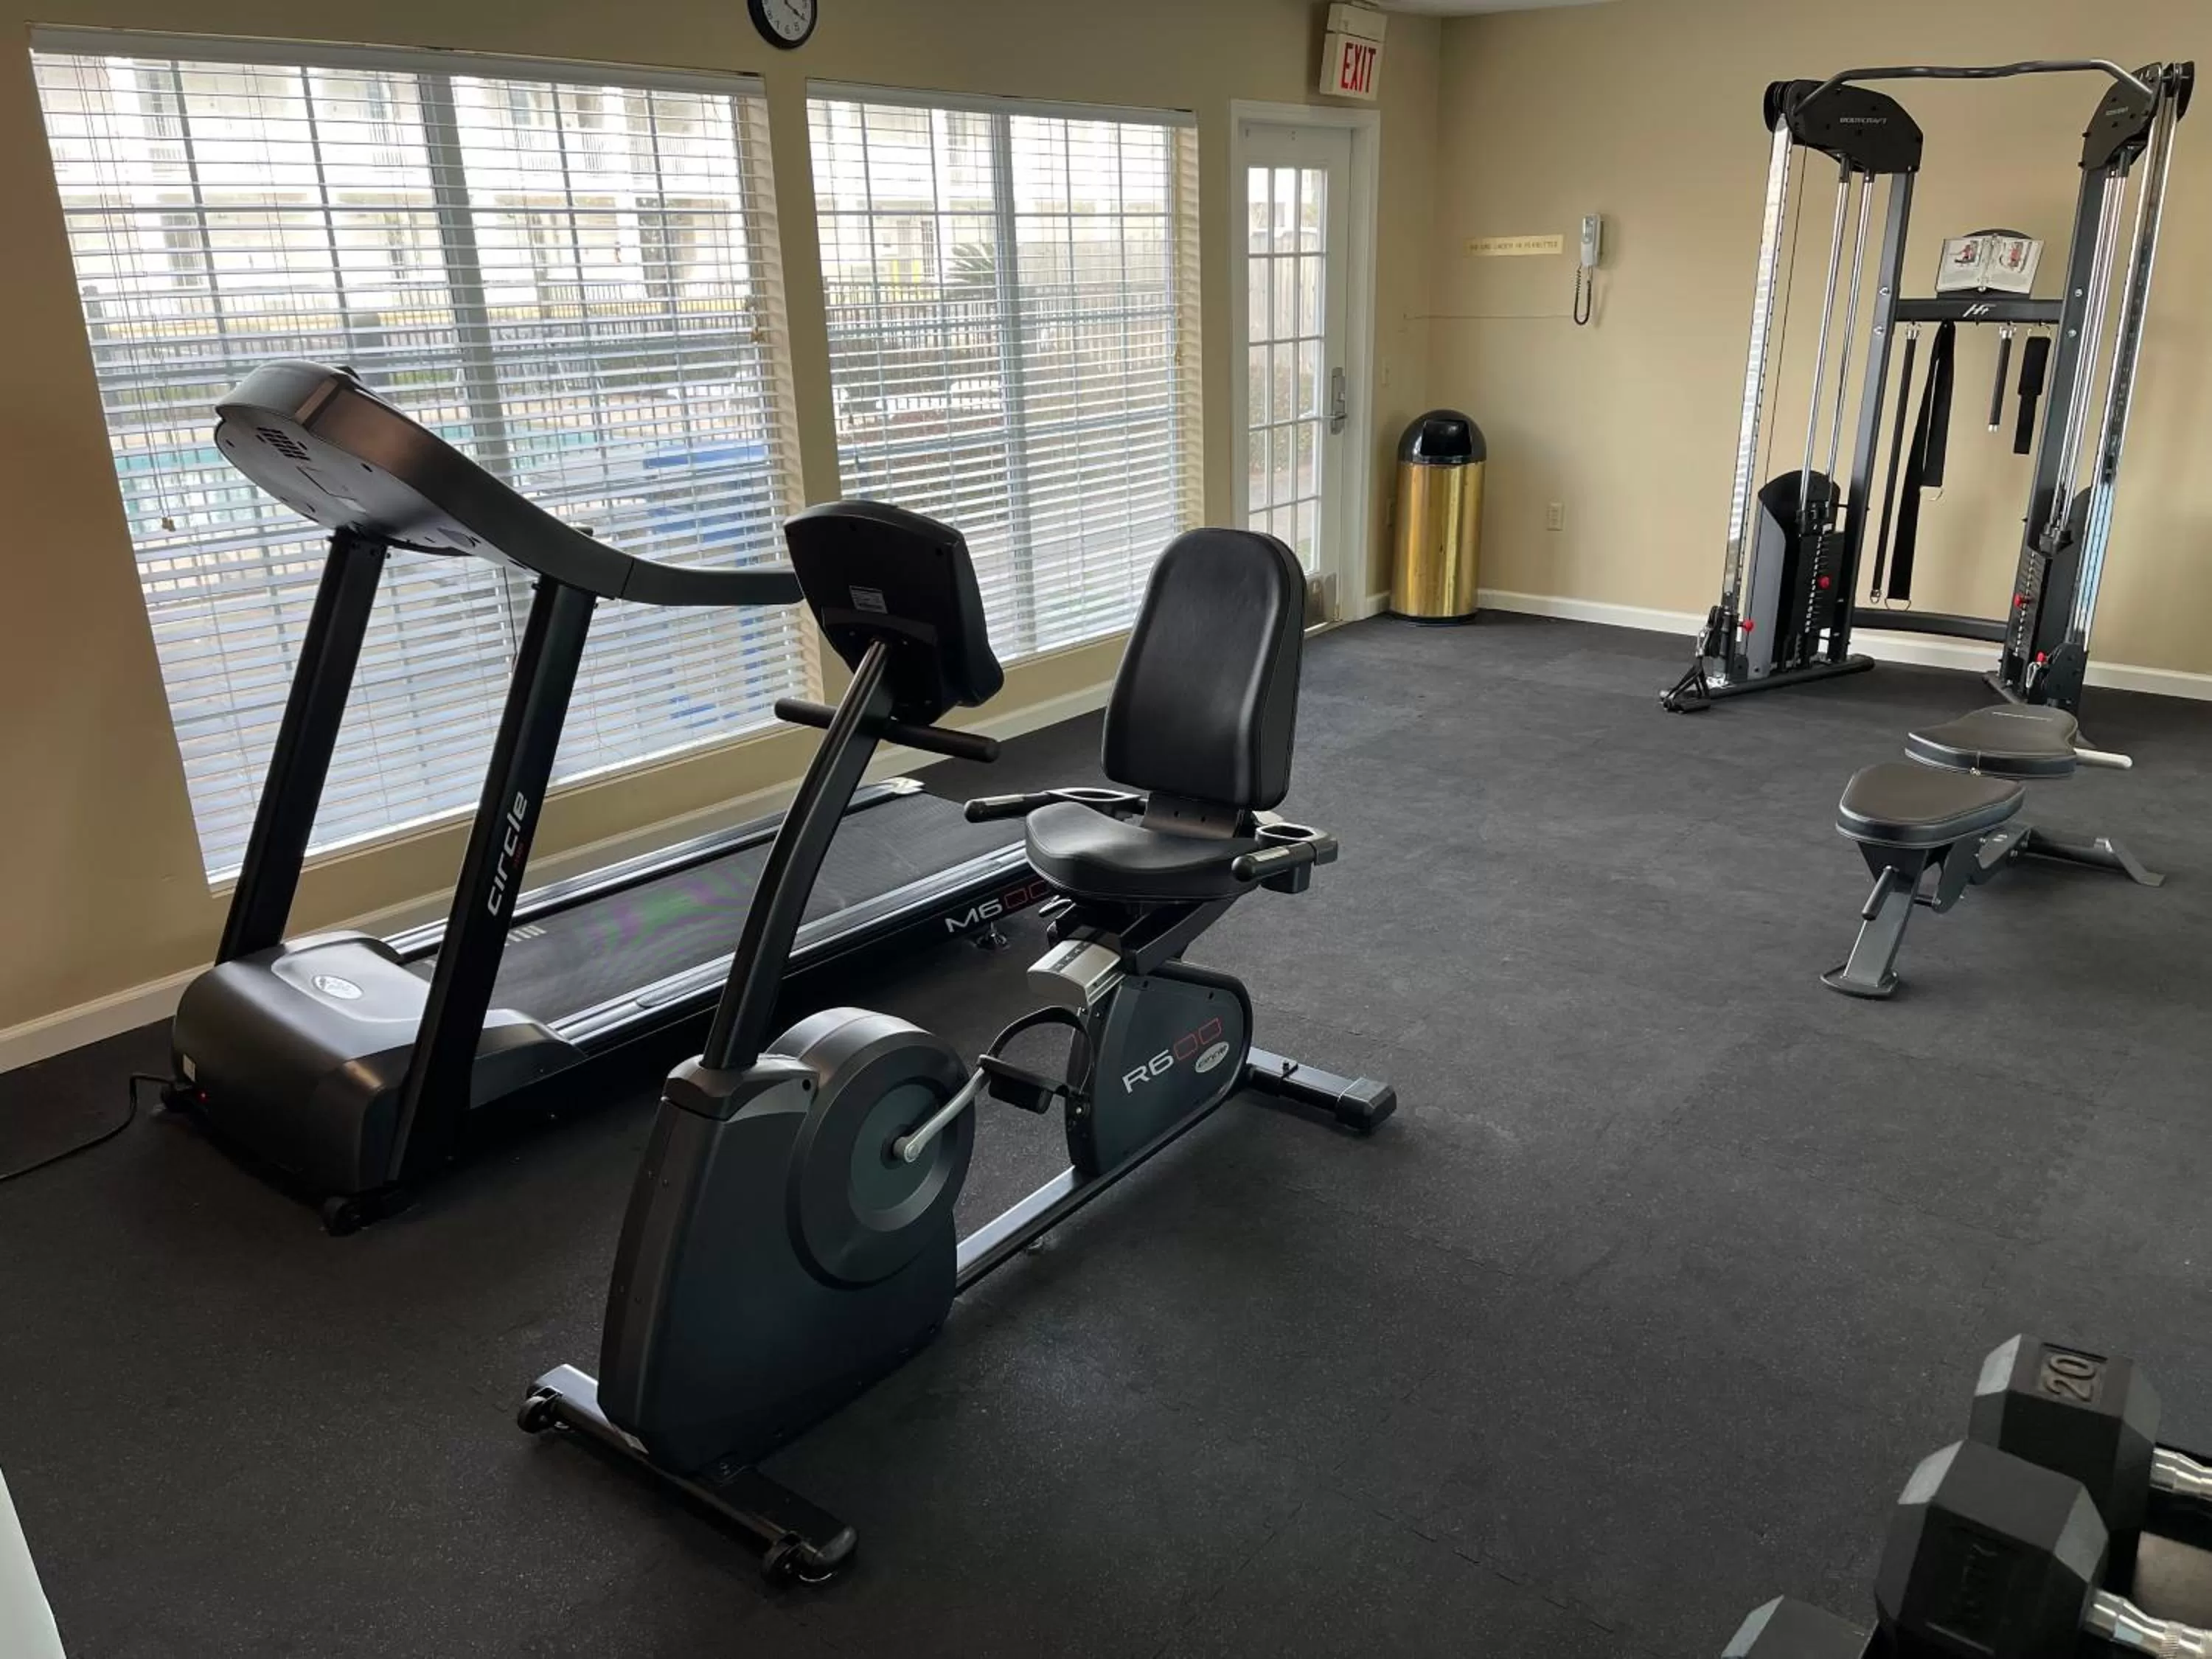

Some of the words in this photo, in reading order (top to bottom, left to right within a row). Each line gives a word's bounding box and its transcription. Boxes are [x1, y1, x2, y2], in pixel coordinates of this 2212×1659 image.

[1341, 42, 1377, 94] EXIT
[487, 790, 527, 917] circle
[1122, 1017, 1222, 1094] R600
[2044, 1354, 2098, 1403] 20
